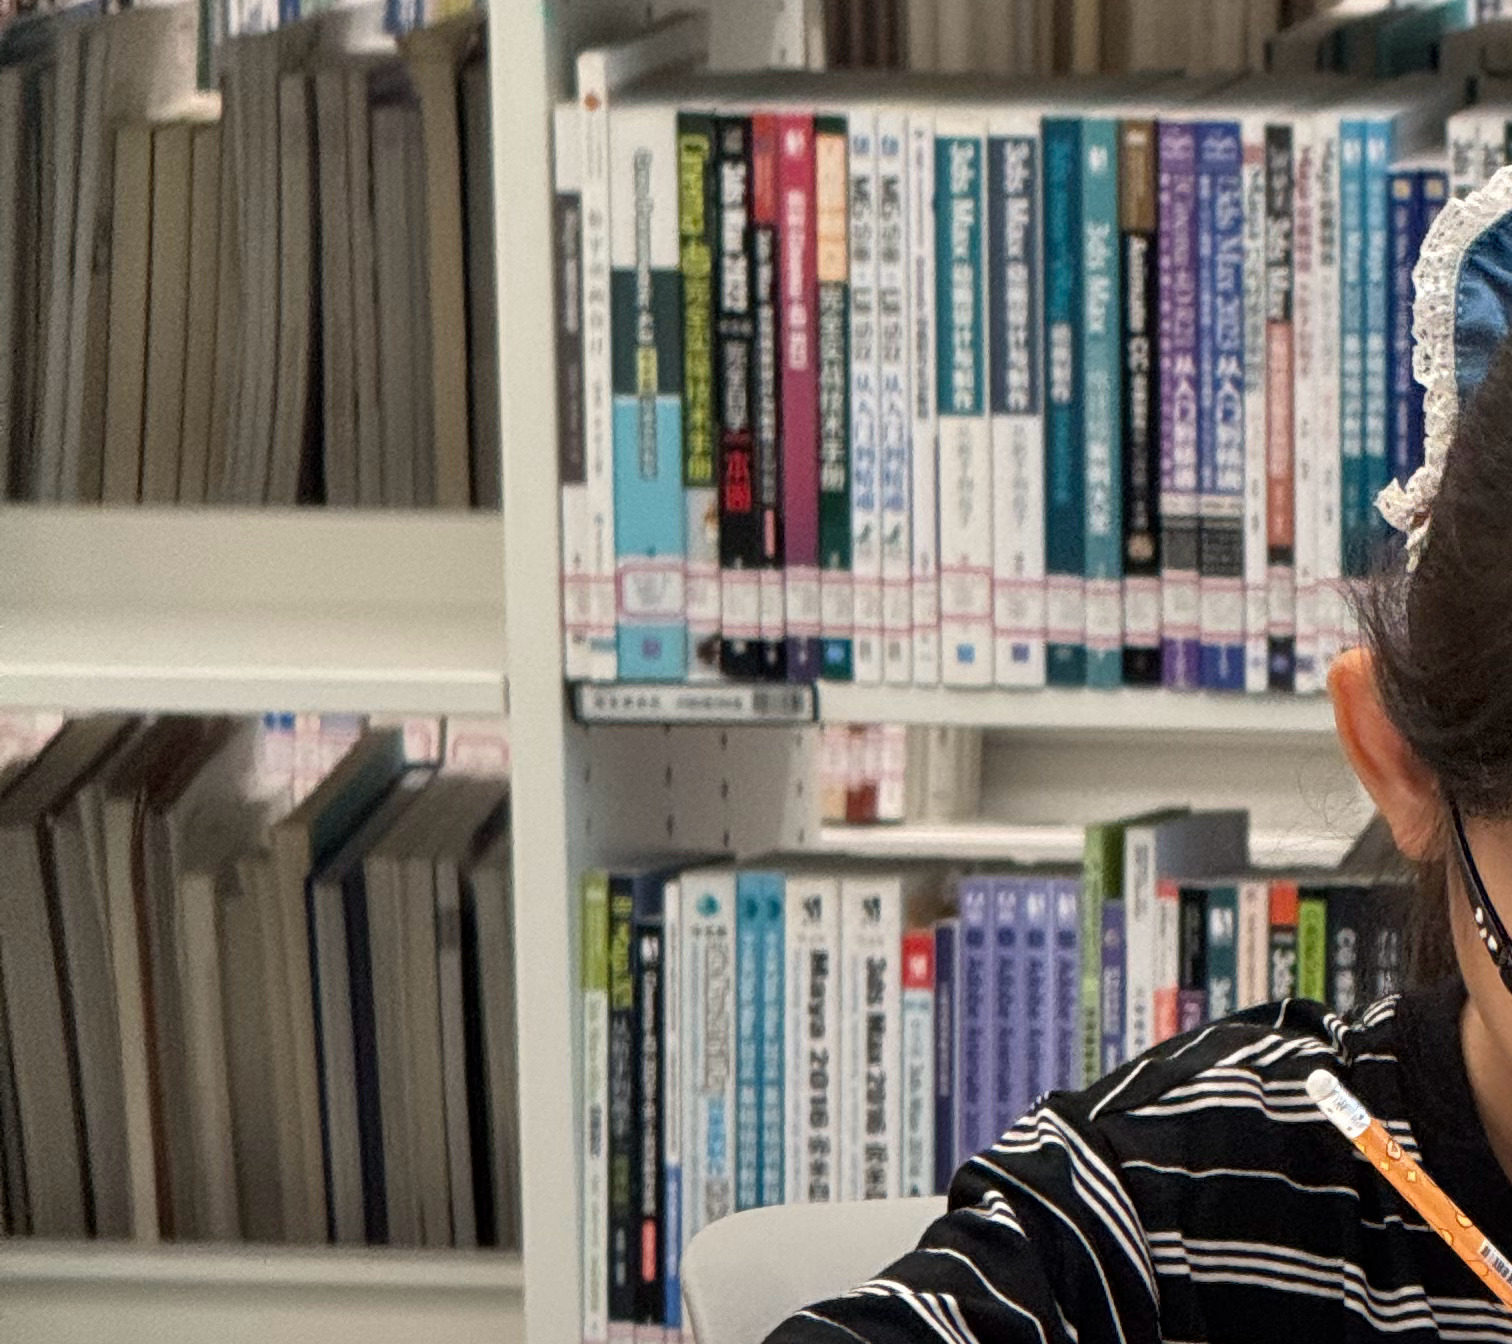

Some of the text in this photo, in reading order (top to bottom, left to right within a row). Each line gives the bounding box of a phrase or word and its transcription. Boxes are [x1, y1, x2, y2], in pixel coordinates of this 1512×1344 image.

[948, 141, 975, 194] 3ds
[1003, 141, 1031, 194] 3ds
[952, 197, 975, 259] Max
[1005, 197, 1030, 259] Max
[807, 949, 830, 1039] Maya
[808, 1047, 831, 1131] 2016
